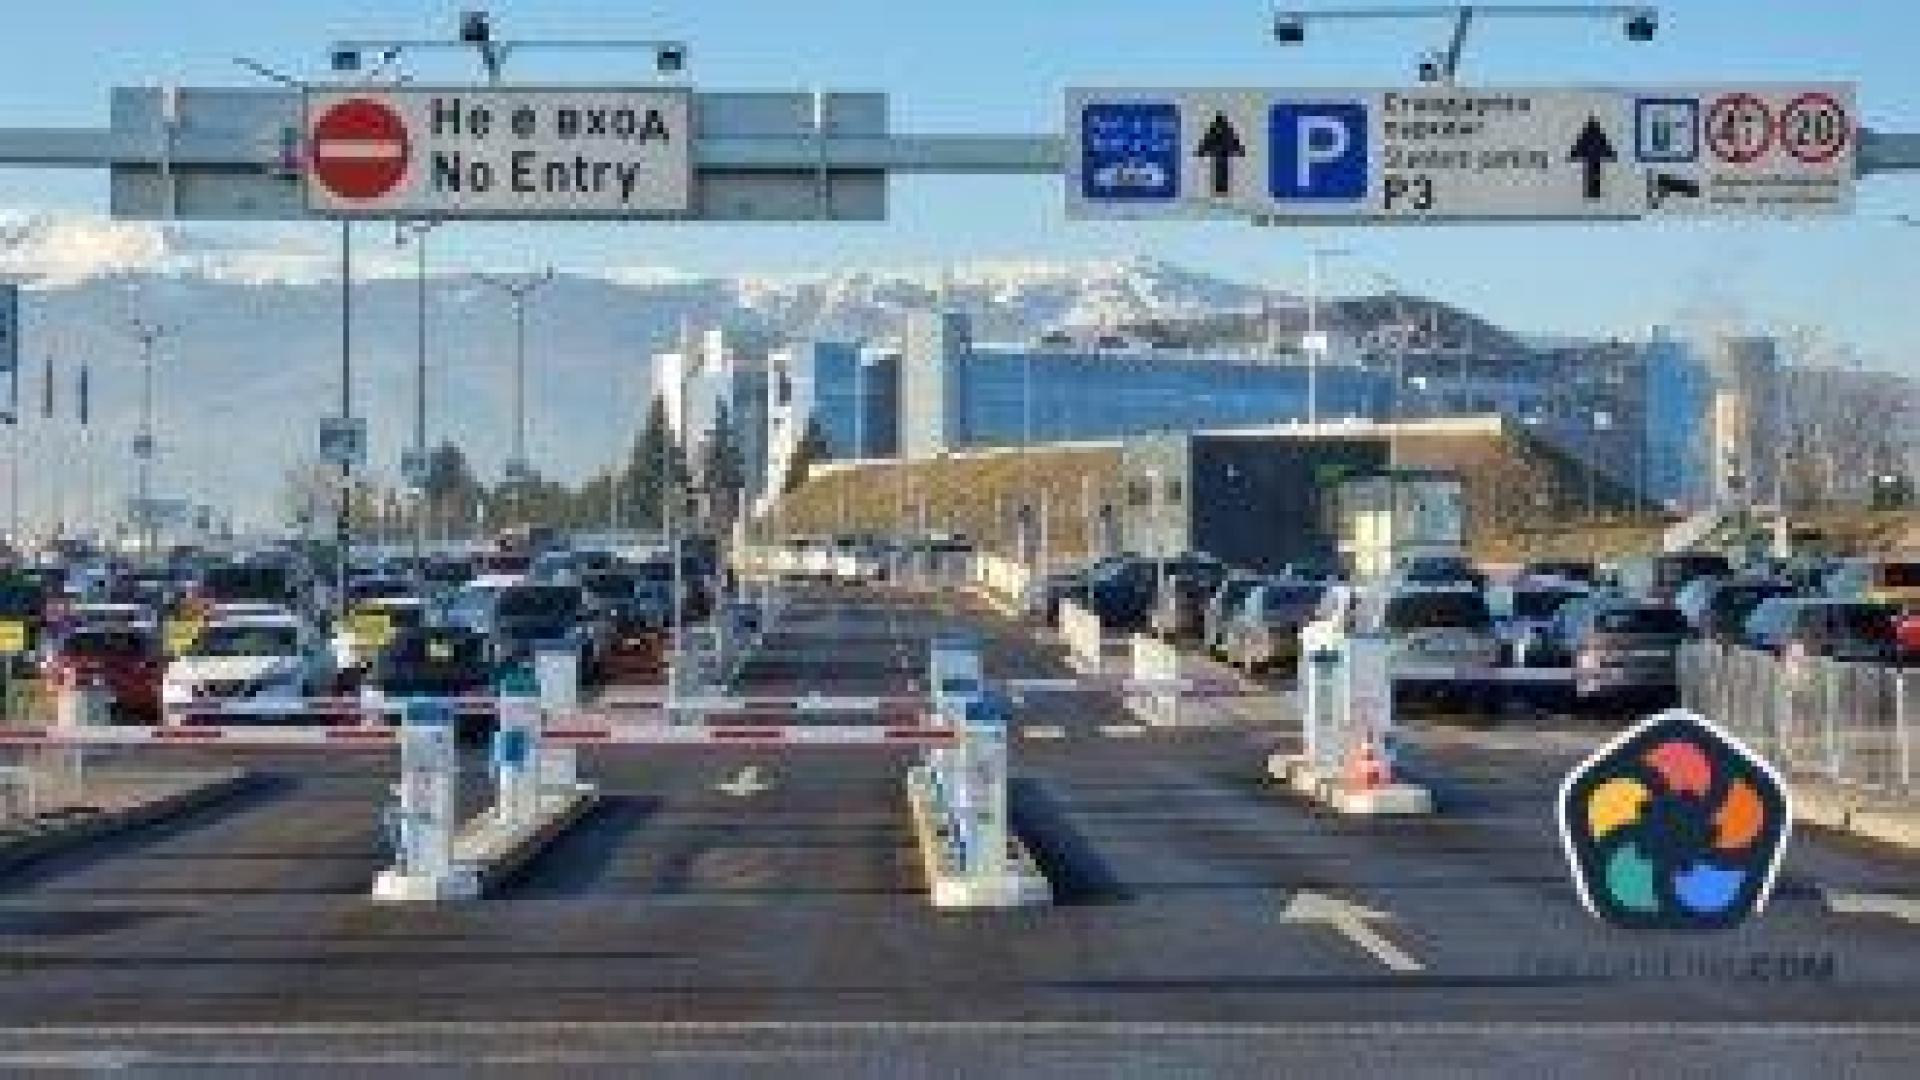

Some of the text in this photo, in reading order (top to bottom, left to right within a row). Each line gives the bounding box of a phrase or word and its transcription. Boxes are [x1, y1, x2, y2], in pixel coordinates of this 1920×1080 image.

[430, 98, 670, 145] Не е вход
[1791, 109, 1834, 147] 20
[431, 149, 641, 201] No Entry
[1296, 115, 1346, 188] P
[1384, 173, 1432, 210] P3
